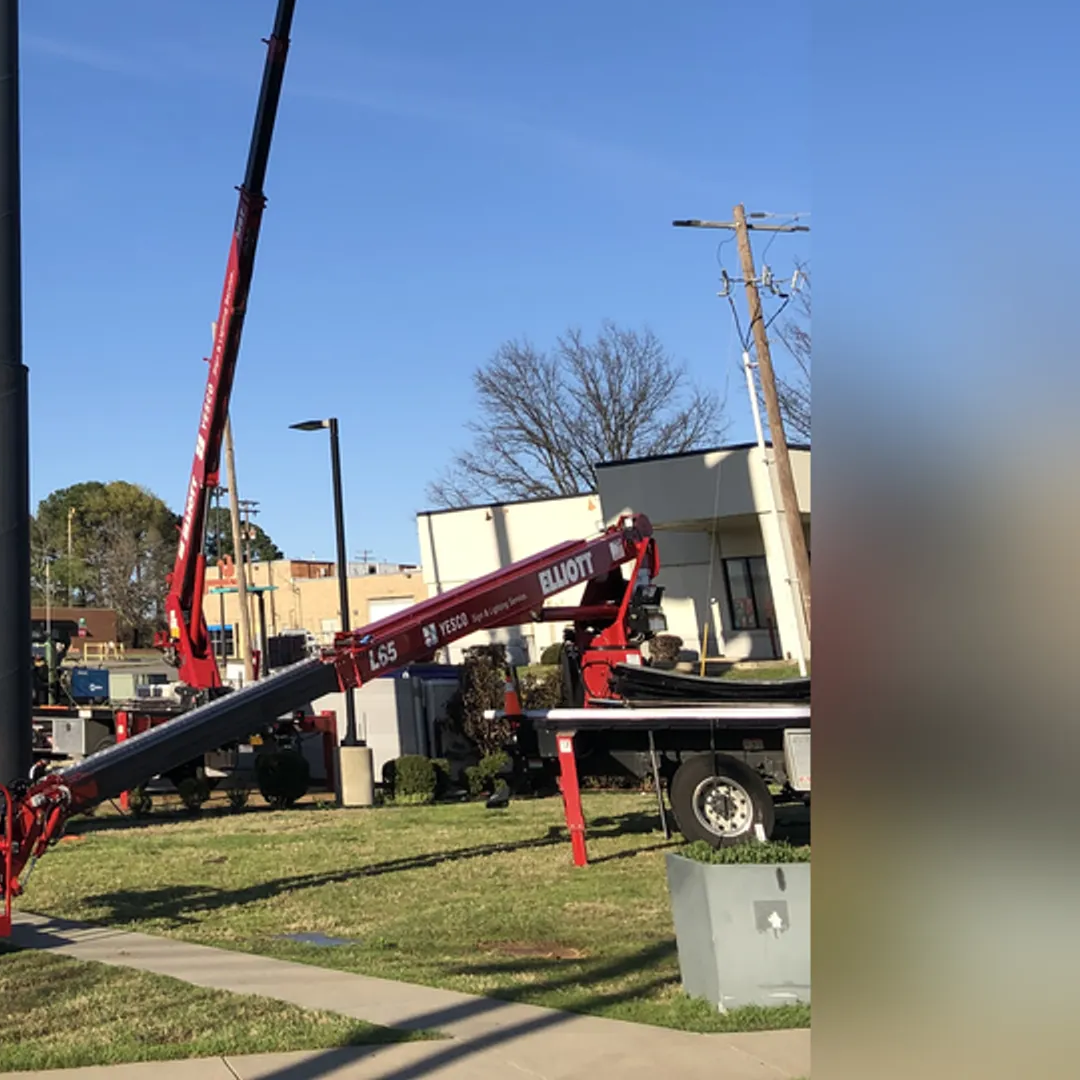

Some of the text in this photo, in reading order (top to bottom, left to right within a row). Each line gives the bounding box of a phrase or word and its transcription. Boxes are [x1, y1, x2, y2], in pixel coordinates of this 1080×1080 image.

[538, 550, 594, 595] ELLIOTT
[439, 612, 468, 636] YESCO
[369, 640, 397, 671] L65
